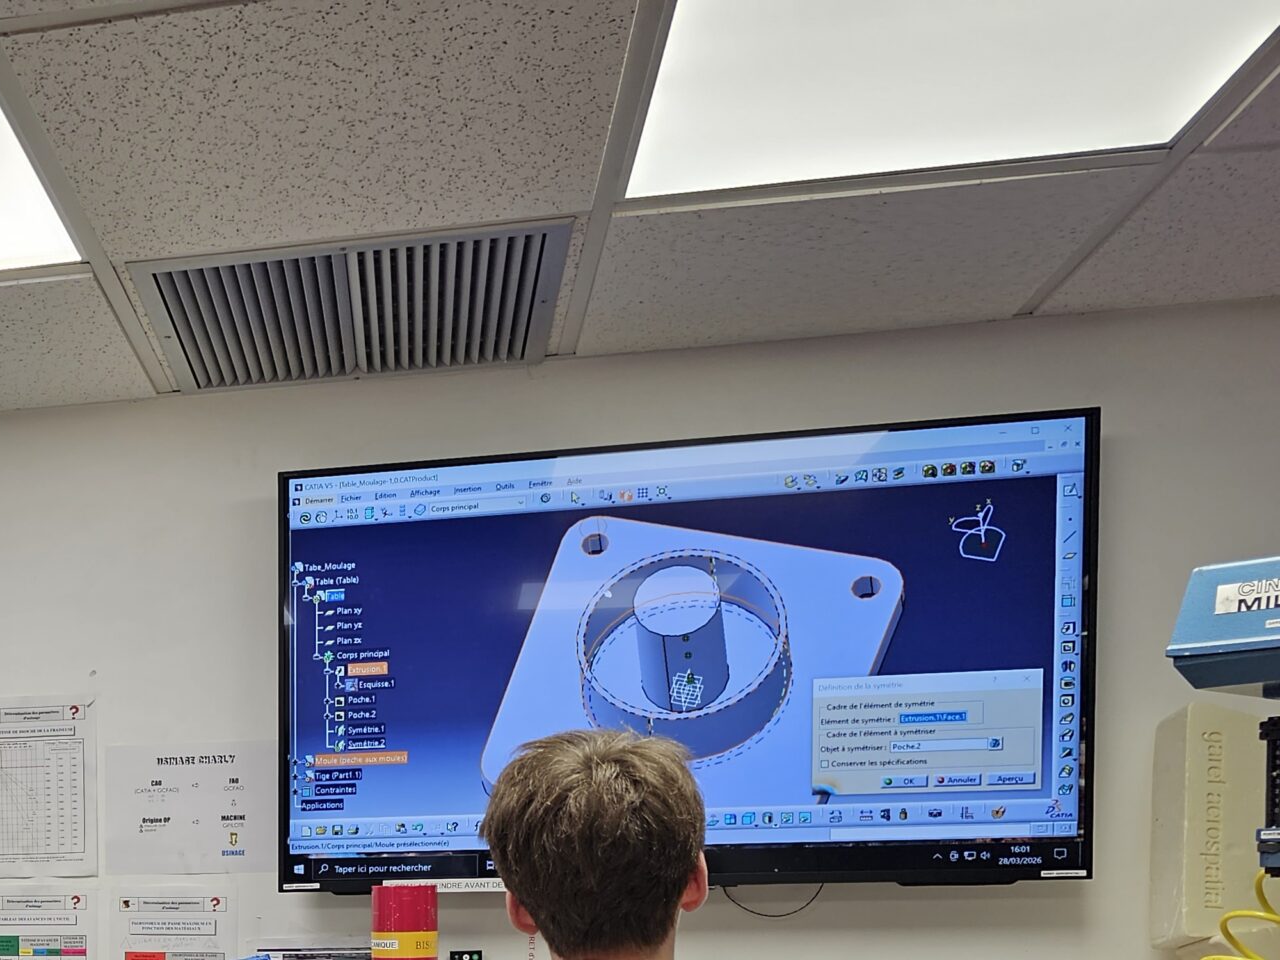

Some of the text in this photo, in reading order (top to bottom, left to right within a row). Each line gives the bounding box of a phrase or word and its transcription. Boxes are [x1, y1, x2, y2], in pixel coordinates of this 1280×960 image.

[340, 494, 362, 503] Fichier
[410, 488, 440, 498] Affichage
[454, 486, 482, 494] Insertion
[496, 483, 515, 491] Outils
[451, 504, 479, 512] principal
[336, 576, 360, 586] (Table)
[354, 608, 362, 616] xy
[354, 622, 363, 630] yz
[360, 650, 390, 658] principal
[359, 680, 395, 690] Esquisse.1
[348, 696, 376, 704] Poche.1
[826, 703, 847, 711] Cadre
[904, 700, 935, 709] symétrie
[348, 710, 376, 719] Poche.2
[861, 716, 892, 726] symétrie
[348, 725, 385, 734] Symétrie.1
[900, 728, 936, 737] symétriser
[348, 740, 386, 748] Symétrie.2
[820, 746, 840, 754] Objet
[831, 760, 866, 768] Conserver
[879, 758, 928, 767] spécifications
[948, 776, 976, 784] Annuler
[997, 774, 1024, 784] Aperçu
[316, 785, 356, 794] Contraintes
[302, 801, 344, 810] Applications
[998, 857, 1042, 866] 28/03/2026
[334, 864, 432, 874] Taper ici pour rechercher
